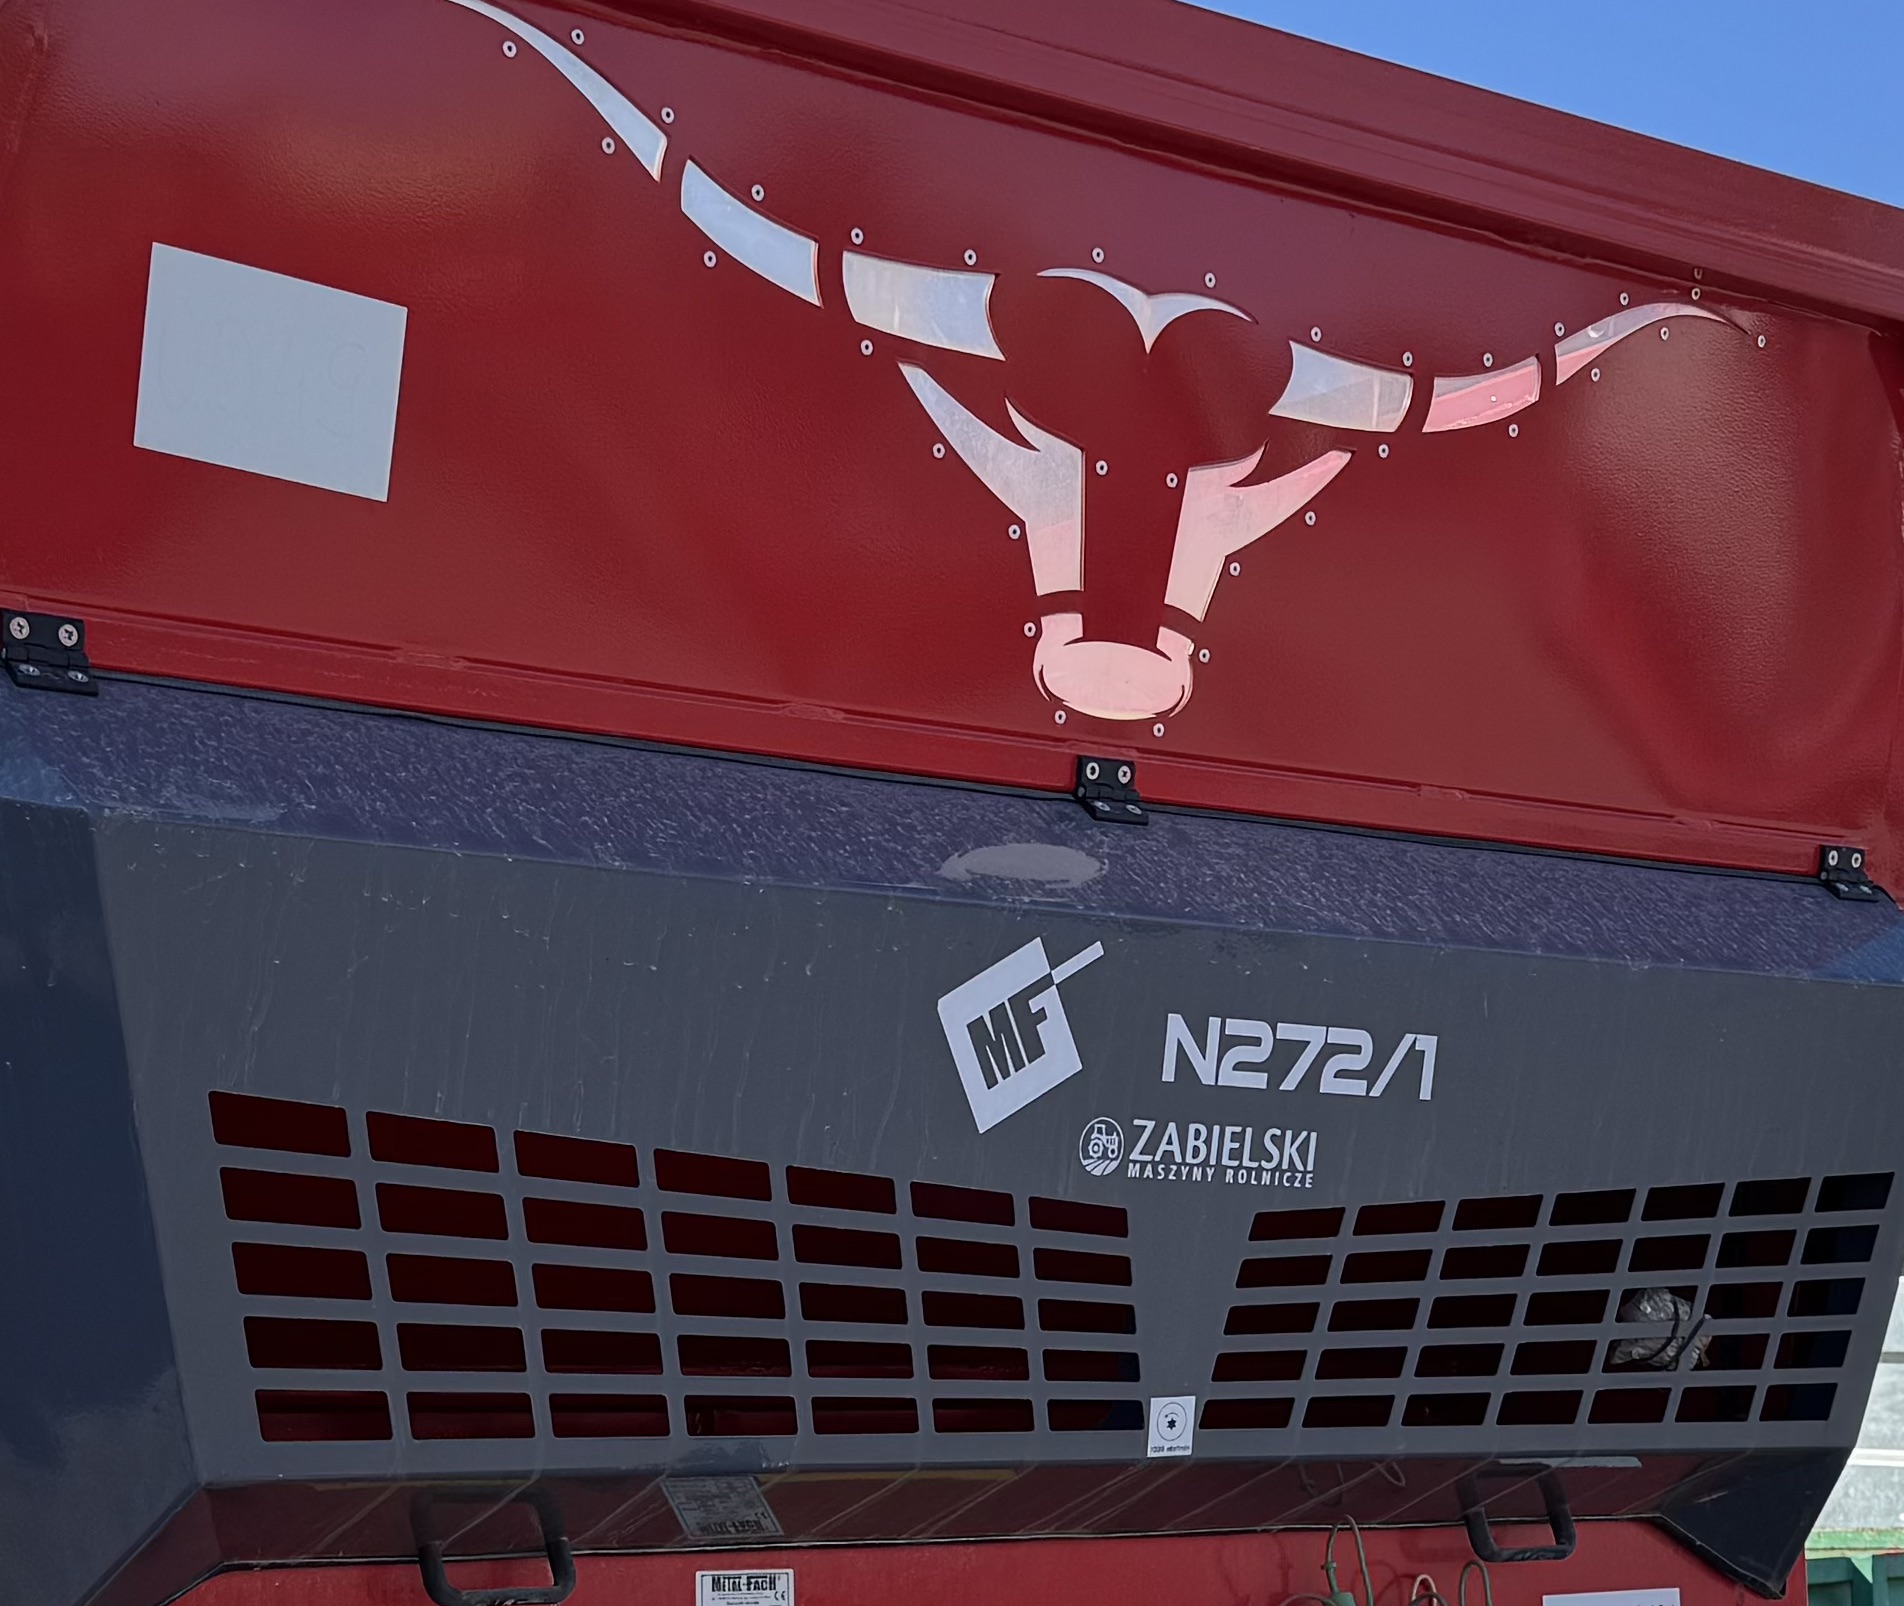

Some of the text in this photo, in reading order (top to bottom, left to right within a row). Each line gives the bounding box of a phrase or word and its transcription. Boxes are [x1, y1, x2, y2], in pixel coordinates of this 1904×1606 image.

[1161, 1012, 1439, 1102] N272/1
[1128, 1117, 1318, 1172] ZABIELSKI
[1127, 1161, 1315, 1190] MASZYNY ROLNICZE
